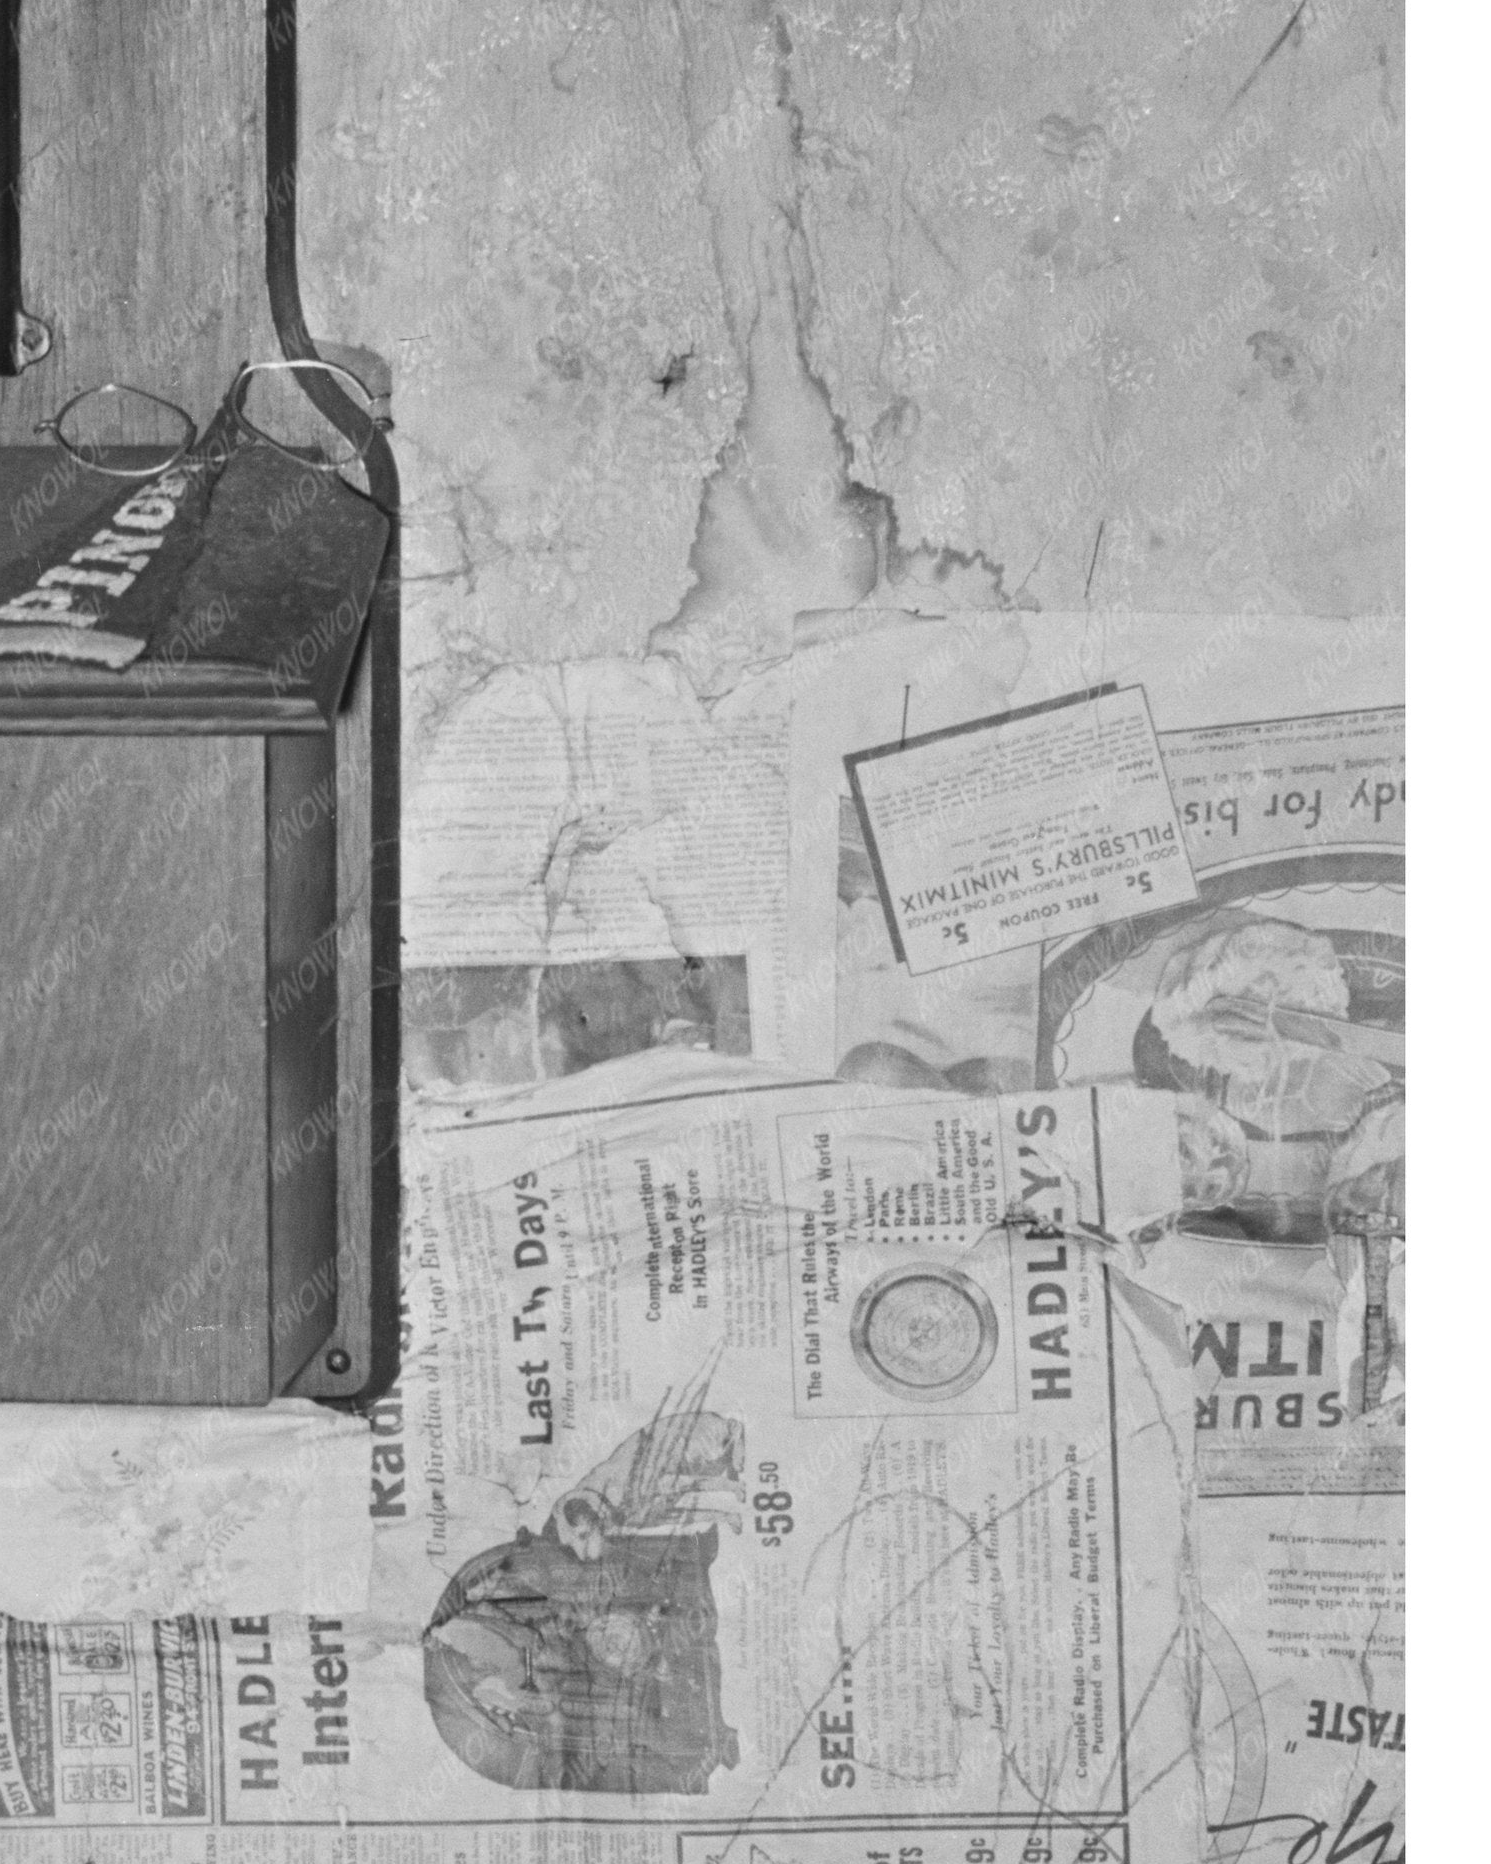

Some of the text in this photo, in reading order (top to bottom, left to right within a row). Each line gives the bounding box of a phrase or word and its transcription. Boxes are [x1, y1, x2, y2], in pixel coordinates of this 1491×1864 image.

[1175, 797, 1239, 837] bis
[1262, 788, 1323, 830] for
[898, 821, 1177, 915] PILLSBURY'S MINITMIX
[905, 844, 1179, 931] GOOD TOWARD THE PURCHASE OF ONE PACKAGE
[998, 891, 1100, 930] FREE COUPON
[862, 1176, 876, 1228] London
[892, 1185, 907, 1227] Rome
[907, 1183, 922, 1227] Berlin
[922, 1182, 937, 1226] Brazil
[933, 1119, 952, 1226] Little America
[949, 1117, 967, 1226] South America
[964, 1130, 983, 1224] and the Good
[979, 1130, 998, 1224] Old U. S. A.
[511, 1170, 550, 1269] Days
[688, 1213, 708, 1289] HADLEY'S
[814, 1132, 841, 1304] Airways of the World
[1015, 1103, 1073, 1402] HADLEY'S
[644, 1251, 663, 1323] Complete
[799, 1212, 823, 1401] The Dial That Rules the
[421, 1275, 450, 1557] Under Direction of Victor
[518, 1360, 553, 1445] Last
[560, 1341, 578, 1430] Friday and
[1062, 1443, 1078, 1464] Be
[1063, 1467, 1081, 1501] May
[752, 1460, 794, 1548] $58.50
[980, 1492, 1000, 1562] Hadley's
[1065, 1506, 1082, 1548] Radio
[985, 1565, 1001, 1584] to
[1066, 1550, 1084, 1580] Any
[962, 1511, 984, 1719] Your Ticket of Admission
[985, 1590, 1004, 1651] Loyalty
[1082, 1475, 1106, 1755] Purchased on Liberal Budget Terms
[1069, 1665, 1087, 1706] Radio
[141, 1689, 157, 1815] BALBOA WINES
[1072, 1711, 1091, 1779] Complete
[3, 1779, 30, 1815] BUY
